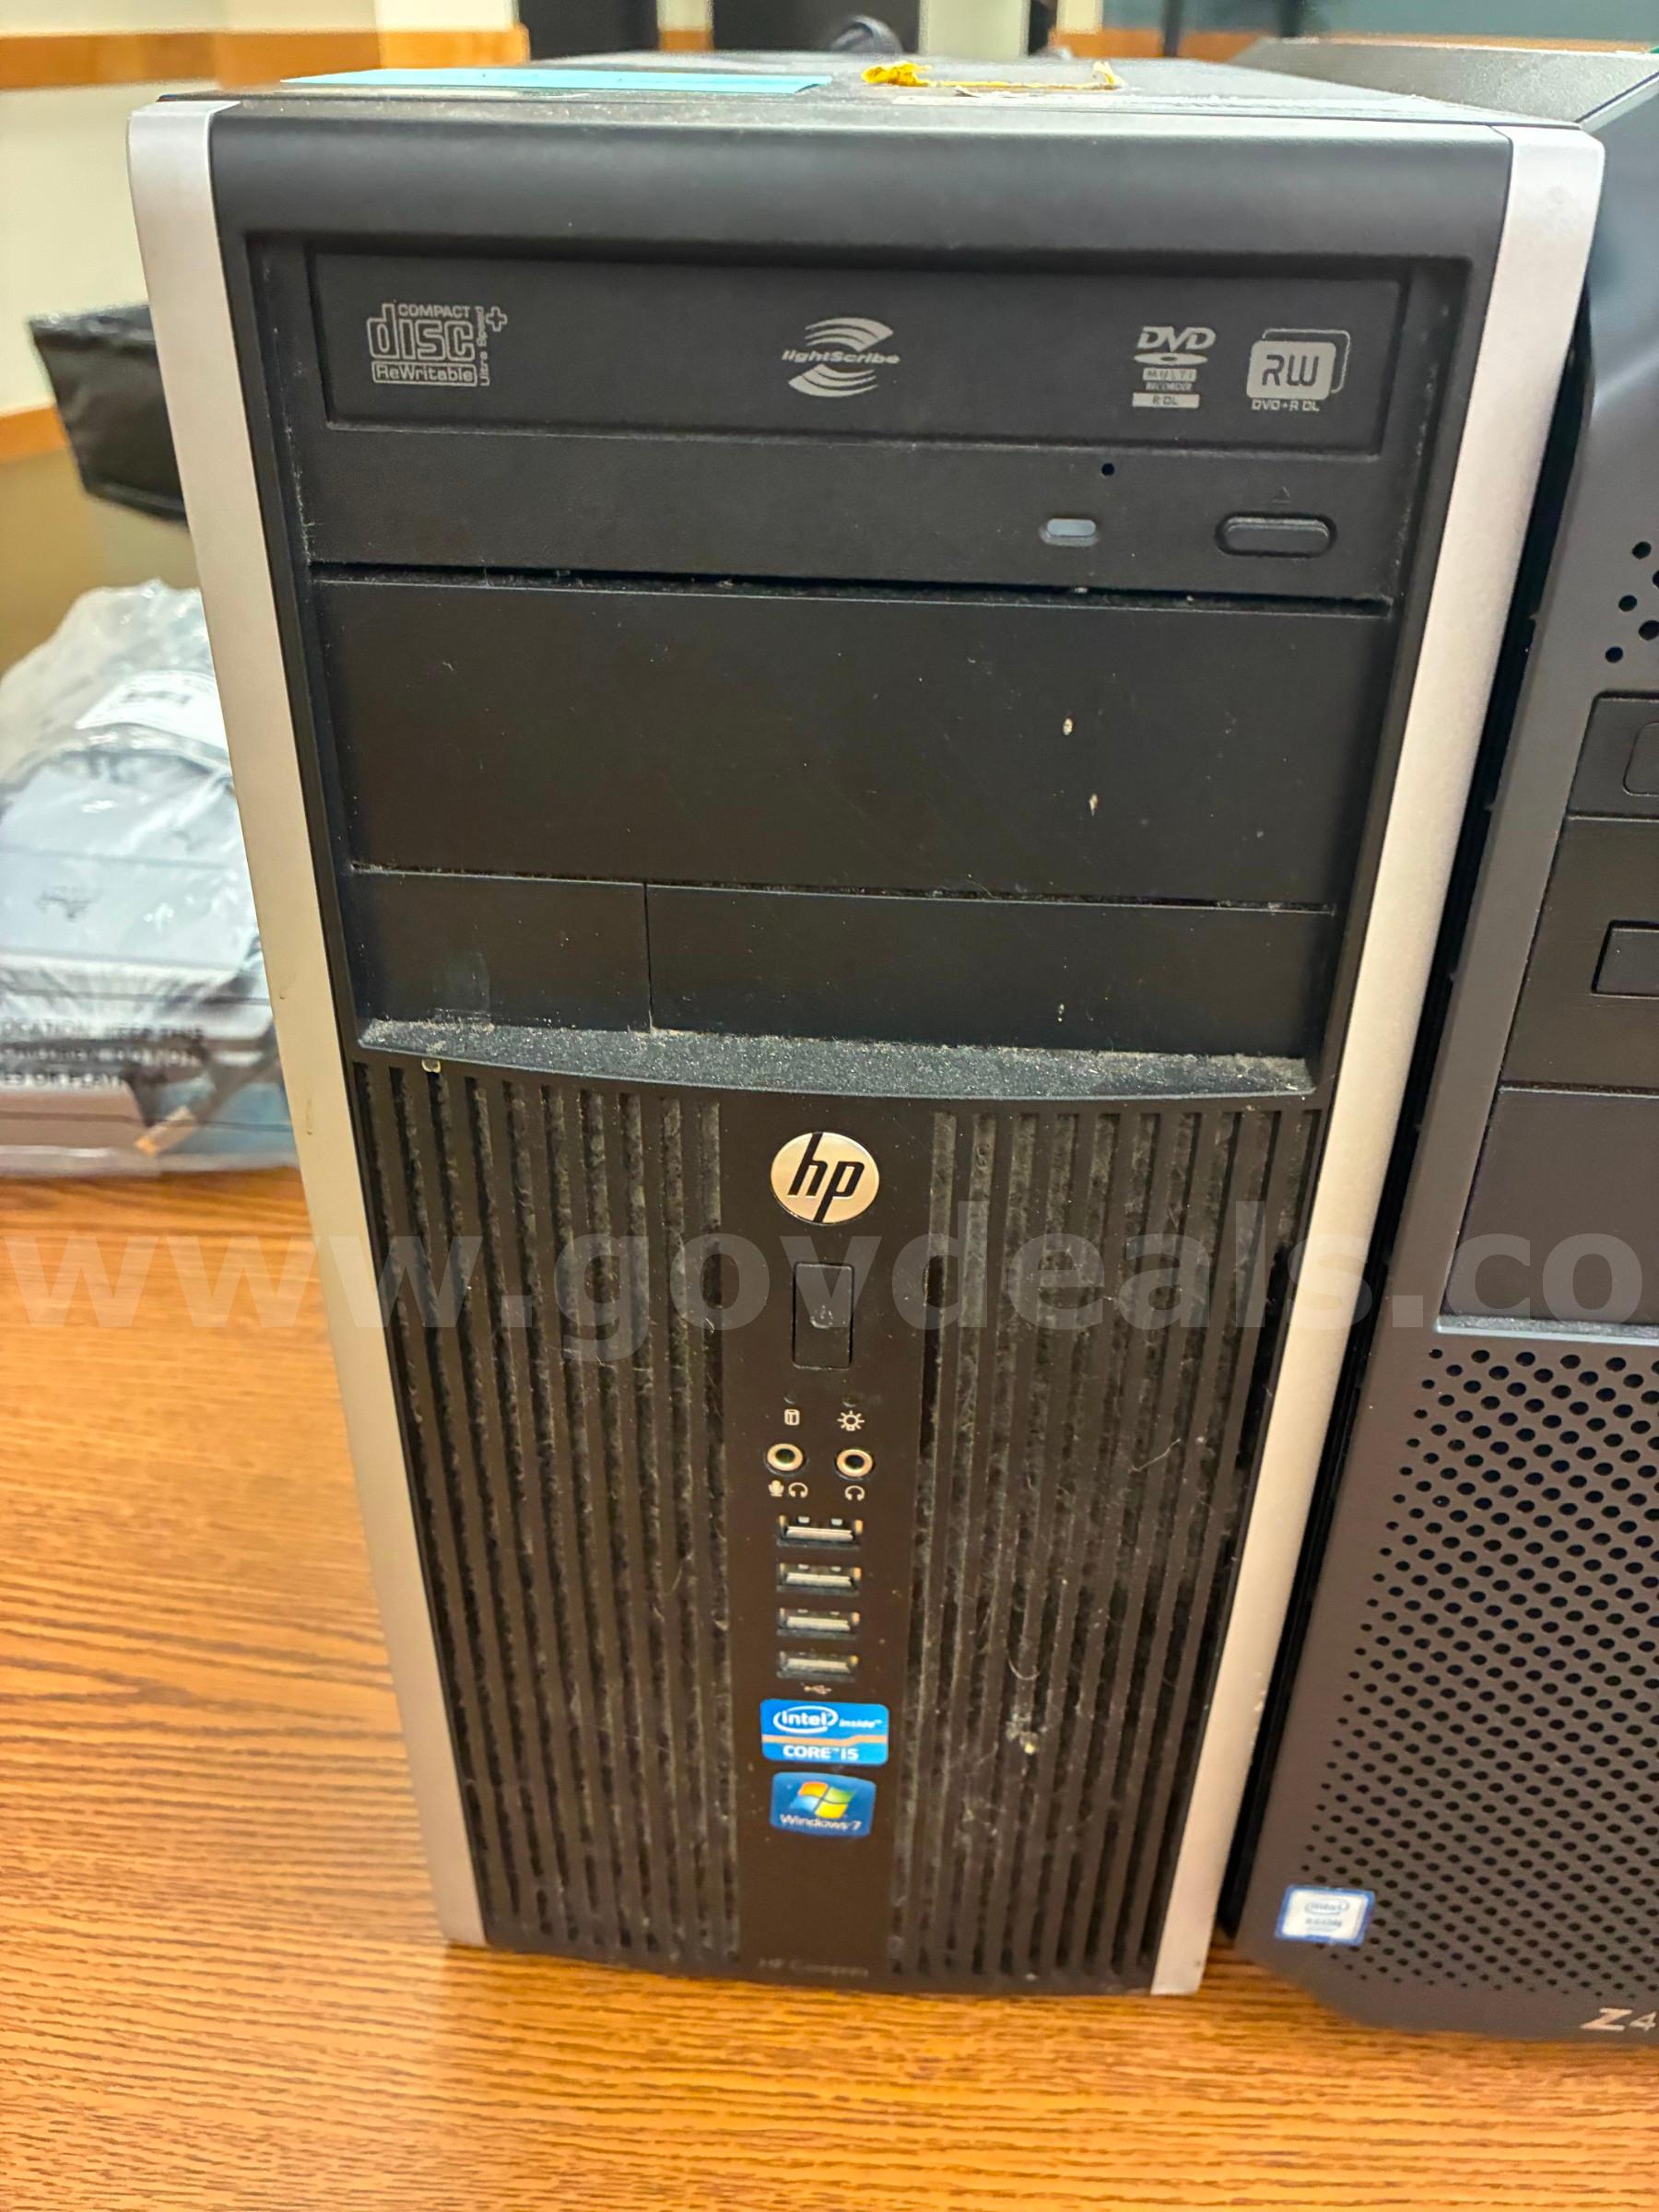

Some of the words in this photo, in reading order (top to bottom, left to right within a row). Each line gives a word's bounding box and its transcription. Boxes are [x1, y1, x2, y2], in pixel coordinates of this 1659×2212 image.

[398, 303, 471, 318] COMPACT
[367, 302, 476, 361] disc
[1137, 326, 1217, 352] DVD
[375, 365, 474, 382] ReWritable
[1262, 354, 1320, 387] RW
[786, 1132, 865, 1224] hp
[782, 1711, 828, 1726] intel
[780, 1814, 849, 1830] Windows
[851, 1819, 862, 1830] 7
